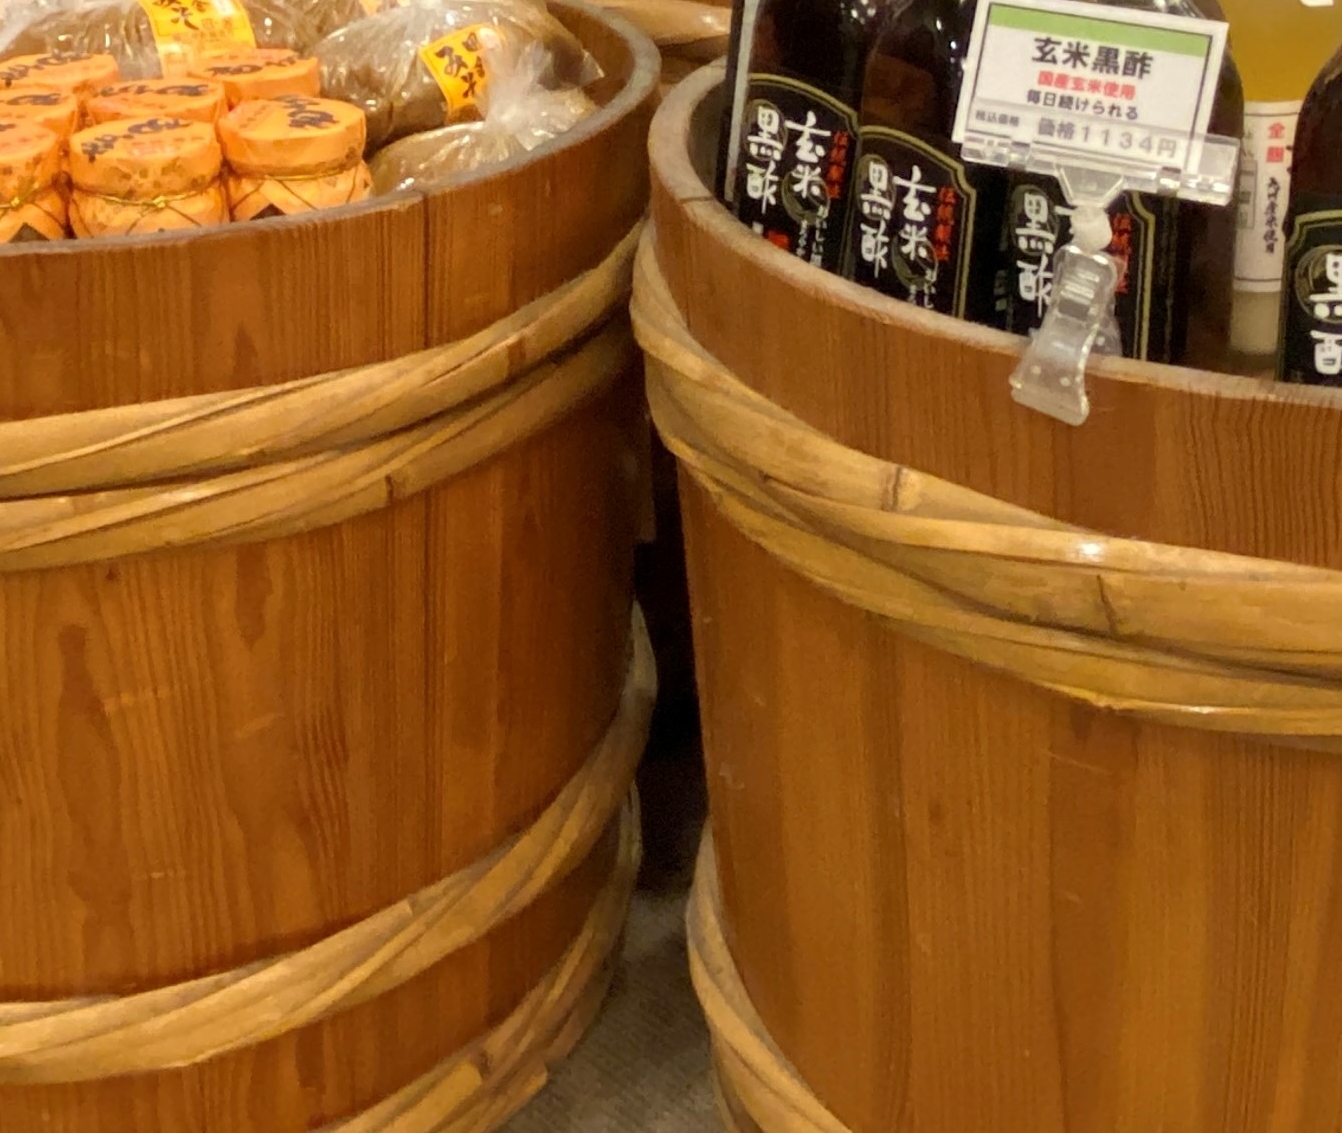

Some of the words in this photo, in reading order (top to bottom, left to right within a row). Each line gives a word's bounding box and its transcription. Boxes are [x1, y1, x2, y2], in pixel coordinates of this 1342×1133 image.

[1032, 35, 1154, 80] 玄米黒酢
[1037, 70, 1137, 101] 国産玄米使用
[1026, 89, 1139, 122] 毎日続けられる
[745, 105, 786, 214] 黒酢
[784, 110, 832, 199] 玄米
[860, 161, 894, 279] 黒酢
[893, 165, 937, 261] 玄米
[1015, 191, 1057, 317] 黒酢
